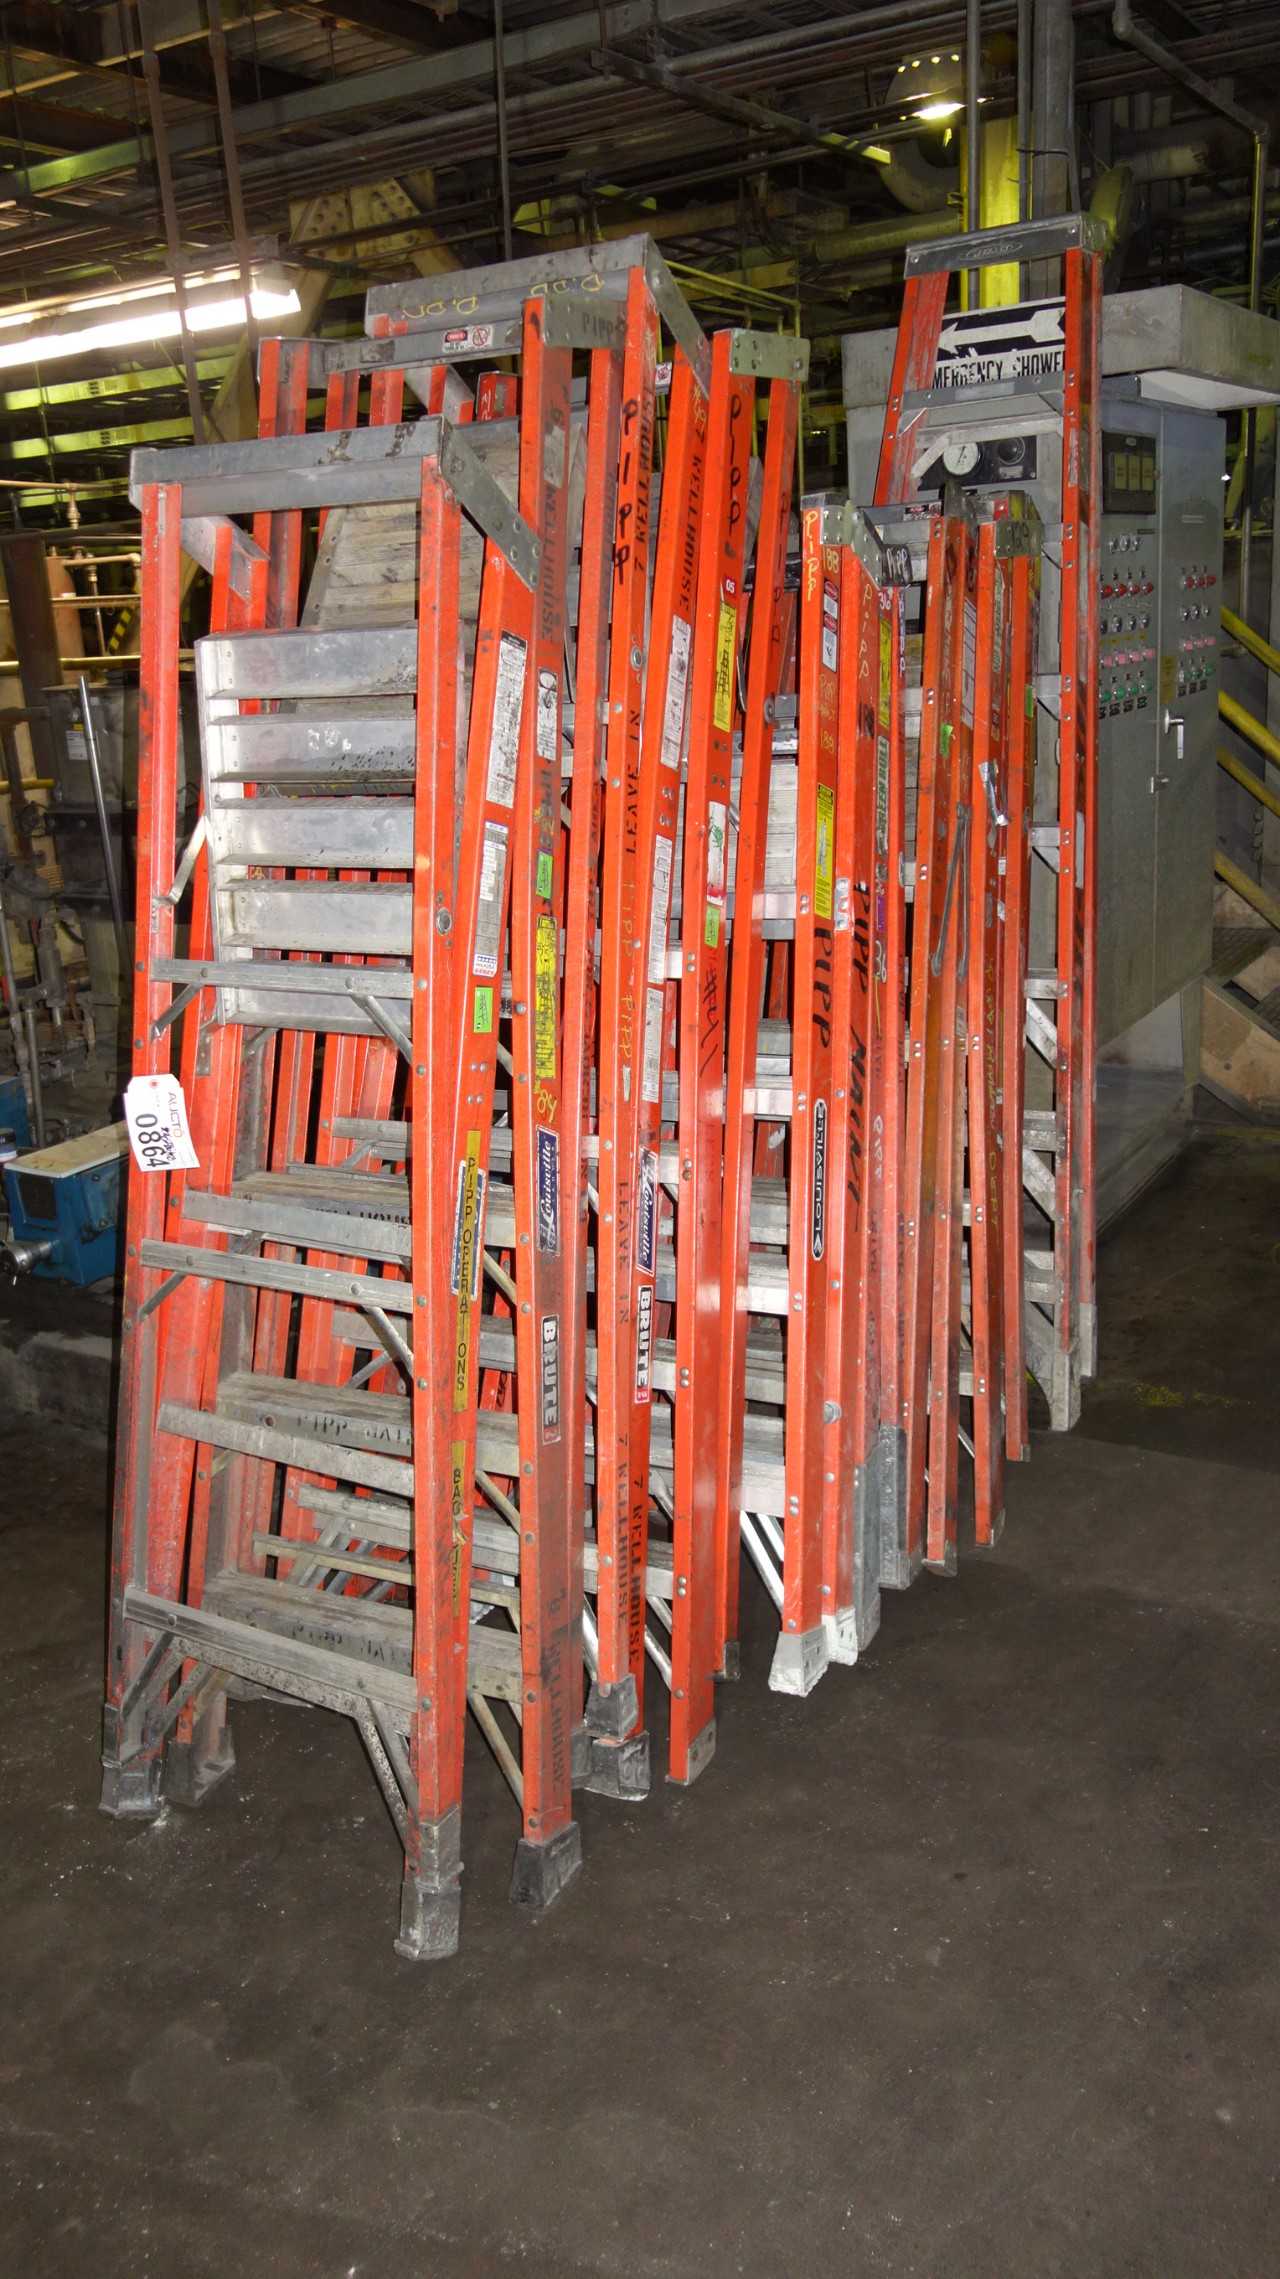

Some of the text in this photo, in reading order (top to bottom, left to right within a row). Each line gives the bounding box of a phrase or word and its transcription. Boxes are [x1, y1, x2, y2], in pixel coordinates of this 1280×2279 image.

[679, 455, 702, 612] KELLHOUSE
[813, 926, 833, 1049] PIPP
[135, 1113, 171, 1168] 0864
[463, 1156, 477, 1220] PIPP
[814, 1101, 827, 1232] LOUISVILLE
[542, 1321, 558, 1426] BRUTE
[637, 1289, 652, 1388] BRUTE
